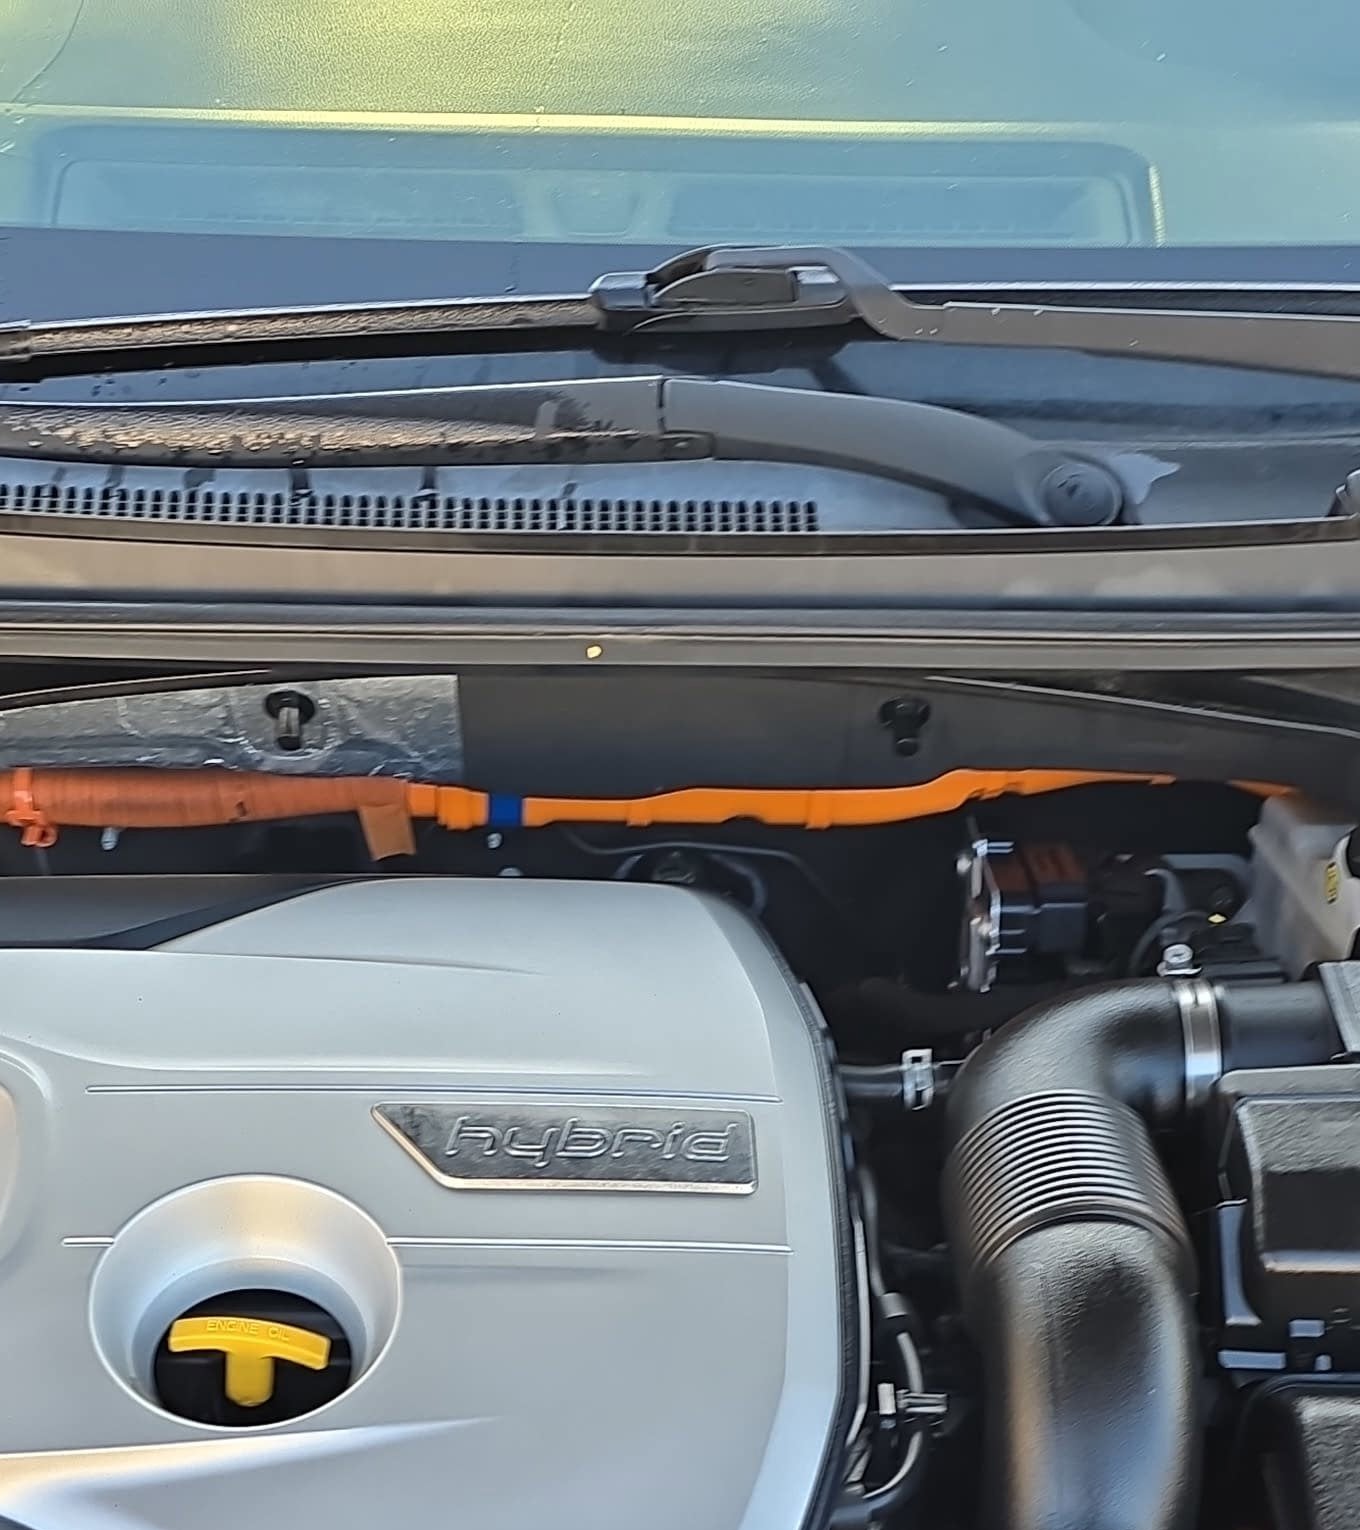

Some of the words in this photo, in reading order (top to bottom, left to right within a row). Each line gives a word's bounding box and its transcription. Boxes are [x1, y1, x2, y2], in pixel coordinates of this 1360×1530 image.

[443, 1115, 740, 1168] hybrid
[206, 1319, 260, 1336] ENGINE
[268, 1327, 290, 1341] OIL
